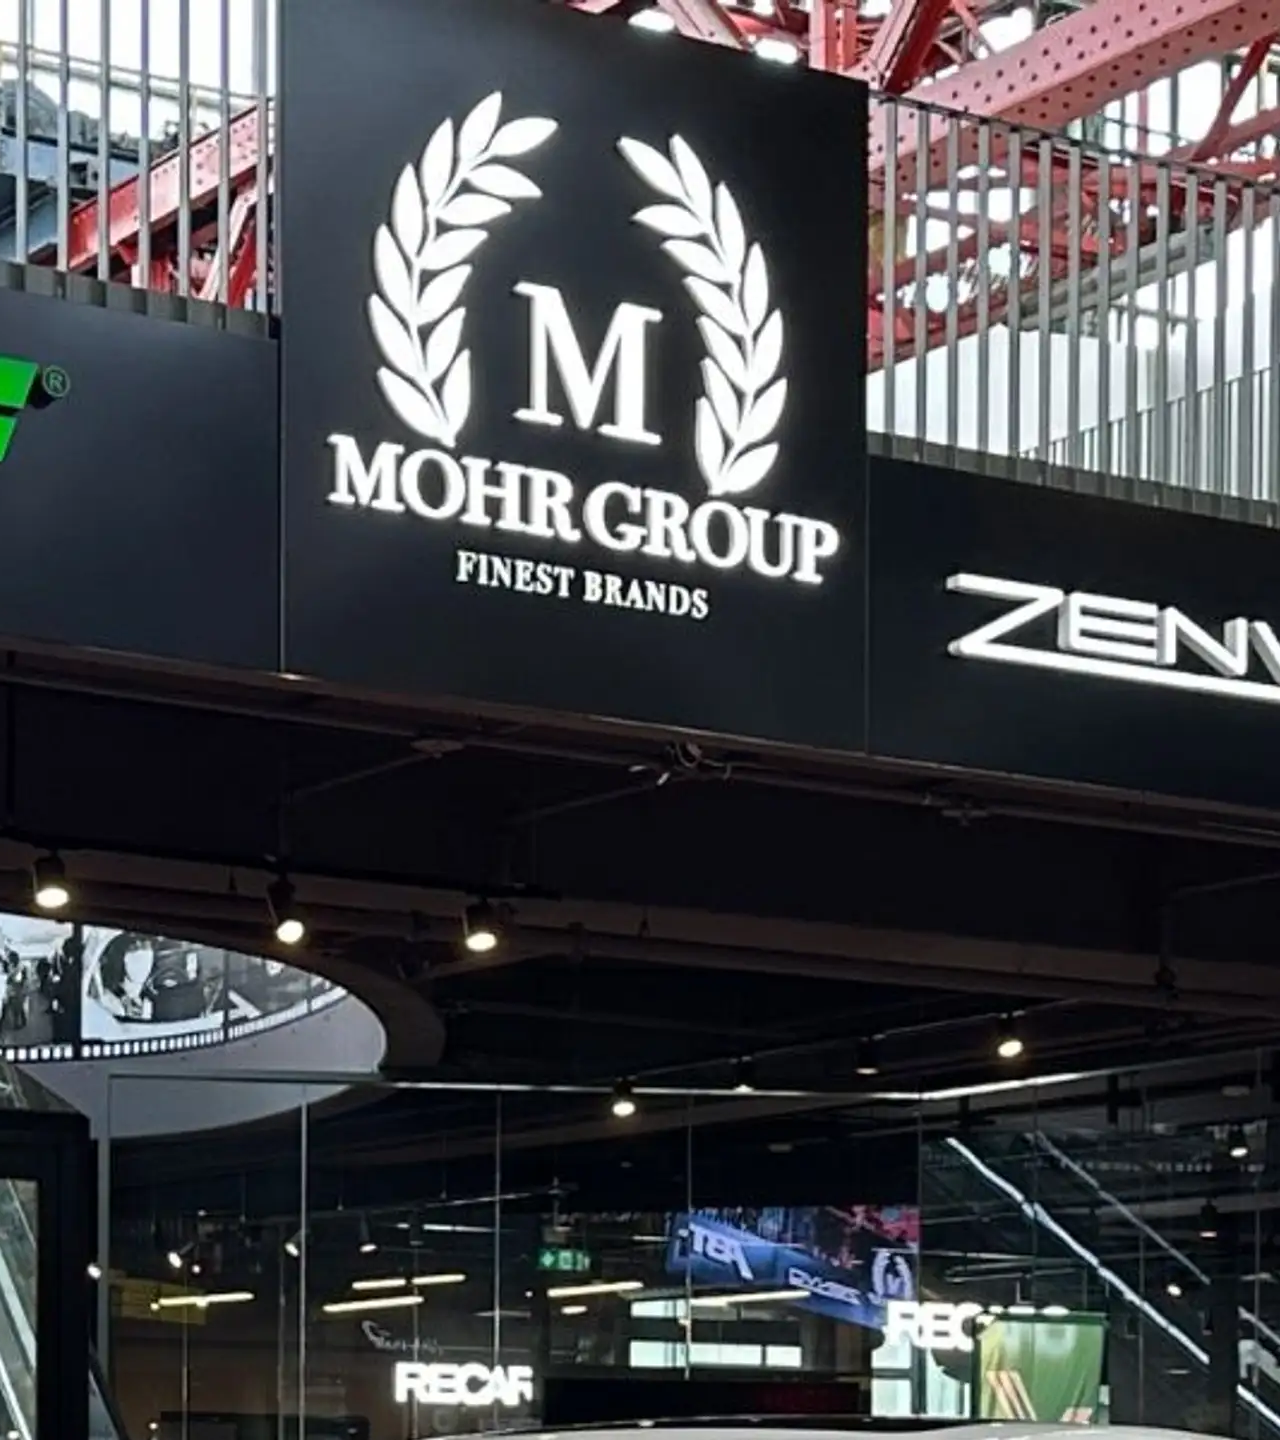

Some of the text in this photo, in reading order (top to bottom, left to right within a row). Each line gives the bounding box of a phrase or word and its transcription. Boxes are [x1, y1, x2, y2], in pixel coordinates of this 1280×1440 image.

[513, 281, 663, 446] M
[327, 433, 841, 584] MOHR GROUP
[455, 549, 710, 620] FINEST BRANDS
